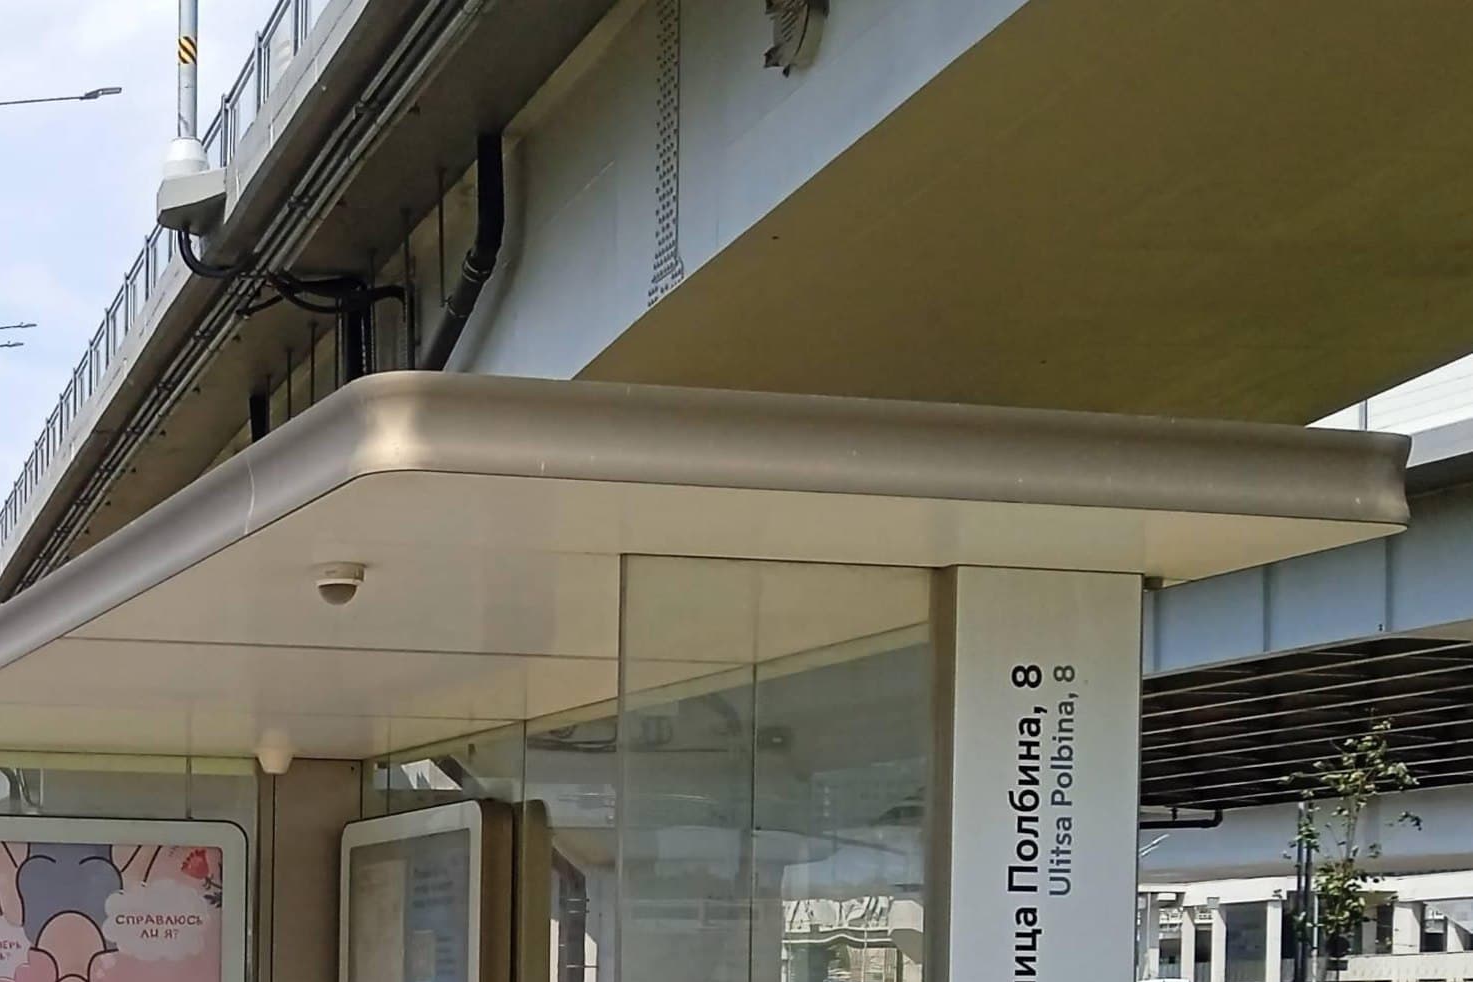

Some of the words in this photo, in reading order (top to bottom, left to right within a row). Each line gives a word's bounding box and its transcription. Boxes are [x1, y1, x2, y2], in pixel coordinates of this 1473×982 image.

[1012, 664, 1042, 688] 8
[1053, 664, 1076, 682] 8
[1051, 692, 1079, 806] Polbina,
[1007, 706, 1047, 892] Полбина,
[1049, 817, 1073, 896] Ulitsa
[115, 914, 203, 925] СПРАВЛЮСЬ
[141, 928, 159, 938] ЛИ
